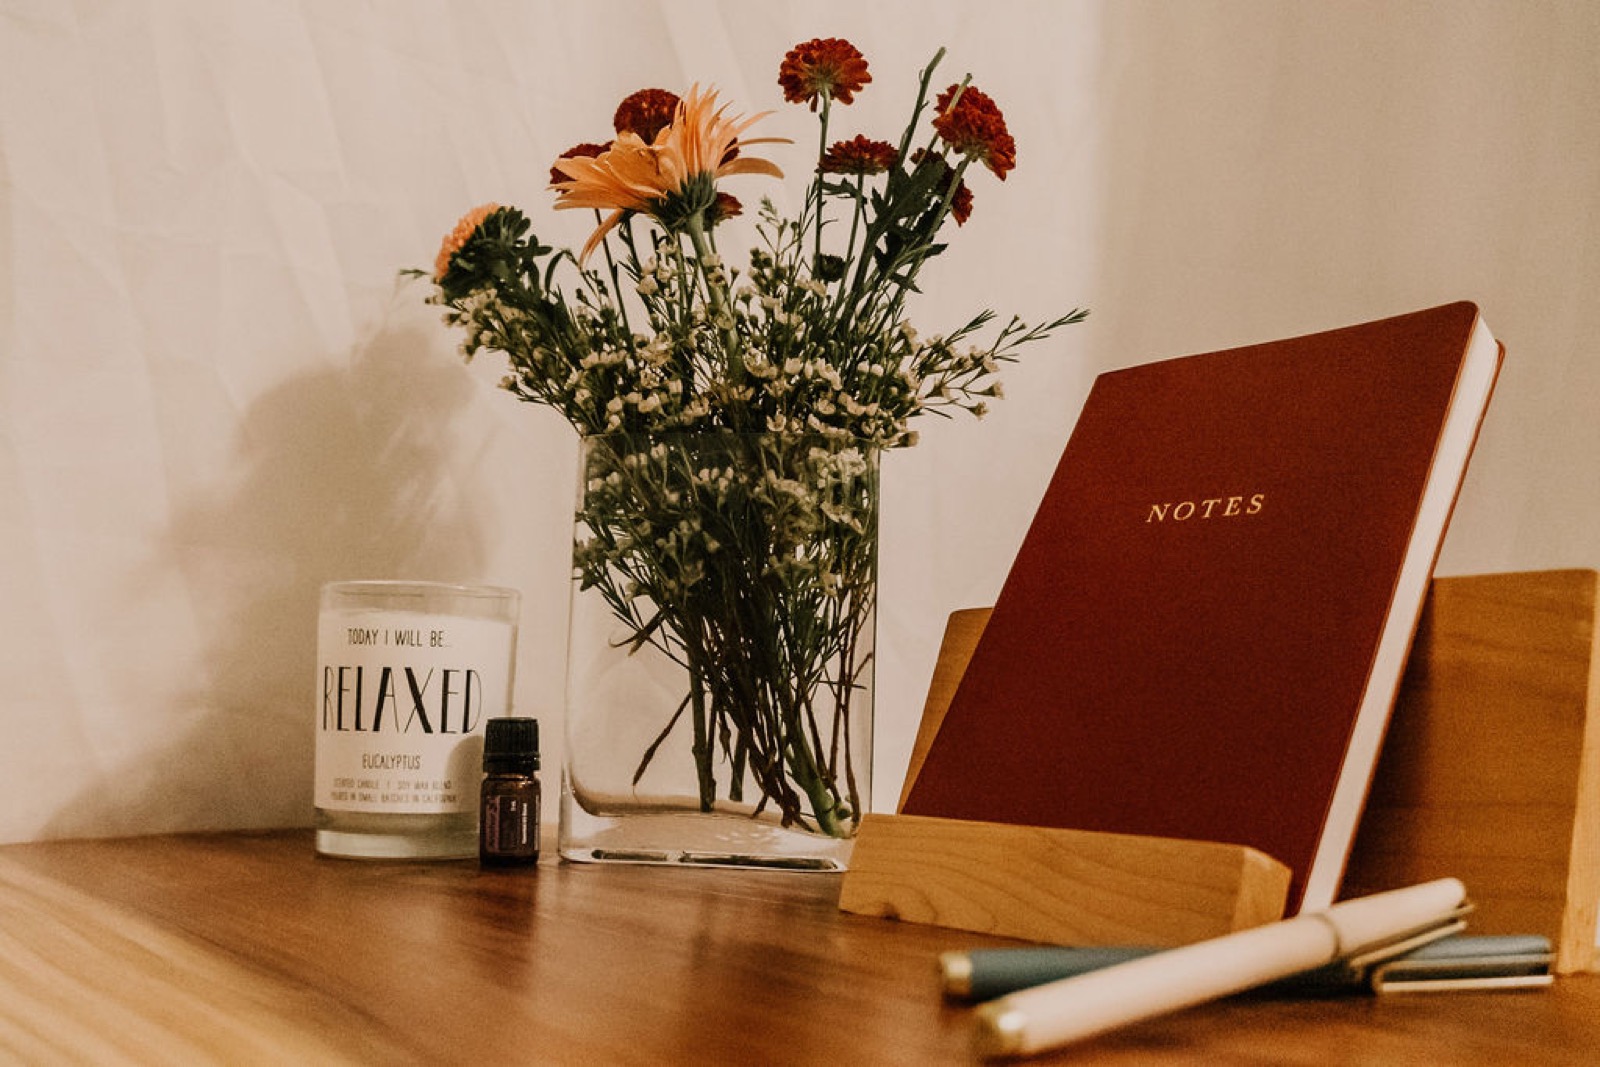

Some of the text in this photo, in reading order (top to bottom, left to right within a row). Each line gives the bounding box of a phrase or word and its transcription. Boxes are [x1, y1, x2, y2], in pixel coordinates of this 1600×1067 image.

[1146, 494, 1265, 523] NOTES
[347, 628, 379, 645] TODAY
[384, 629, 388, 646] I
[394, 629, 422, 647] WILL
[323, 666, 482, 734] RELAXED
[362, 753, 421, 770] EUCALYPTUS
